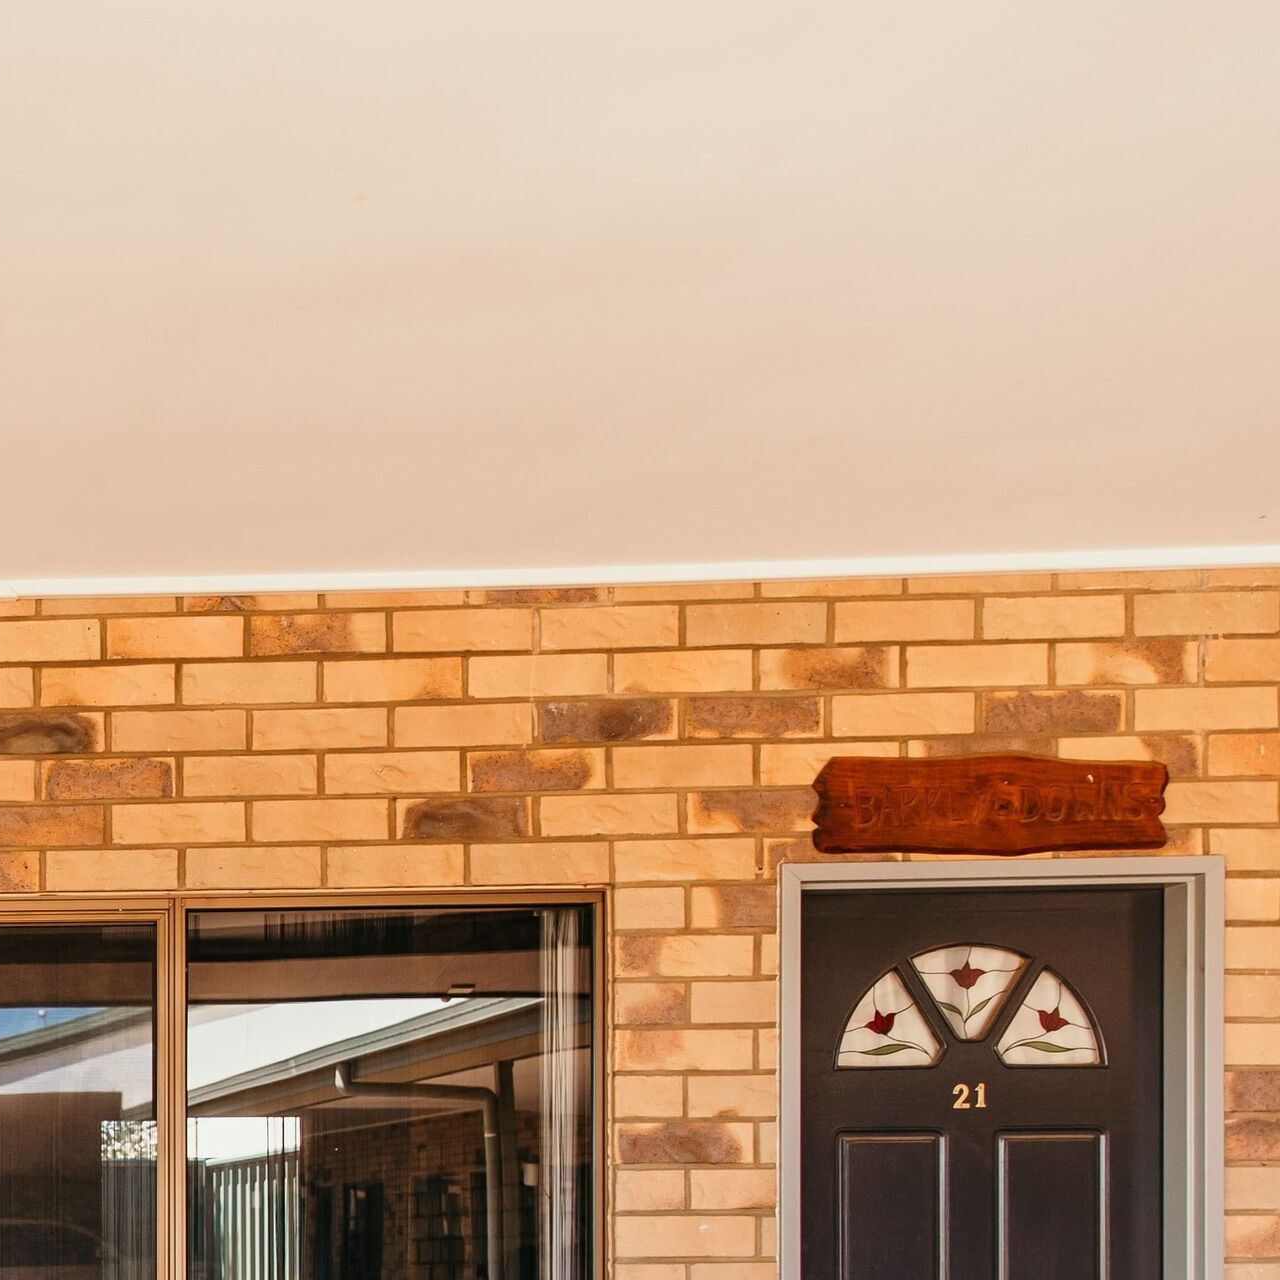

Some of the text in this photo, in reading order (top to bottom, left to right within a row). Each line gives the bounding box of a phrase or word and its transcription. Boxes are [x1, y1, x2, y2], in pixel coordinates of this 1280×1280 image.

[852, 782, 1146, 827] BARKLY DOWNS
[952, 1083, 986, 1109] 21
